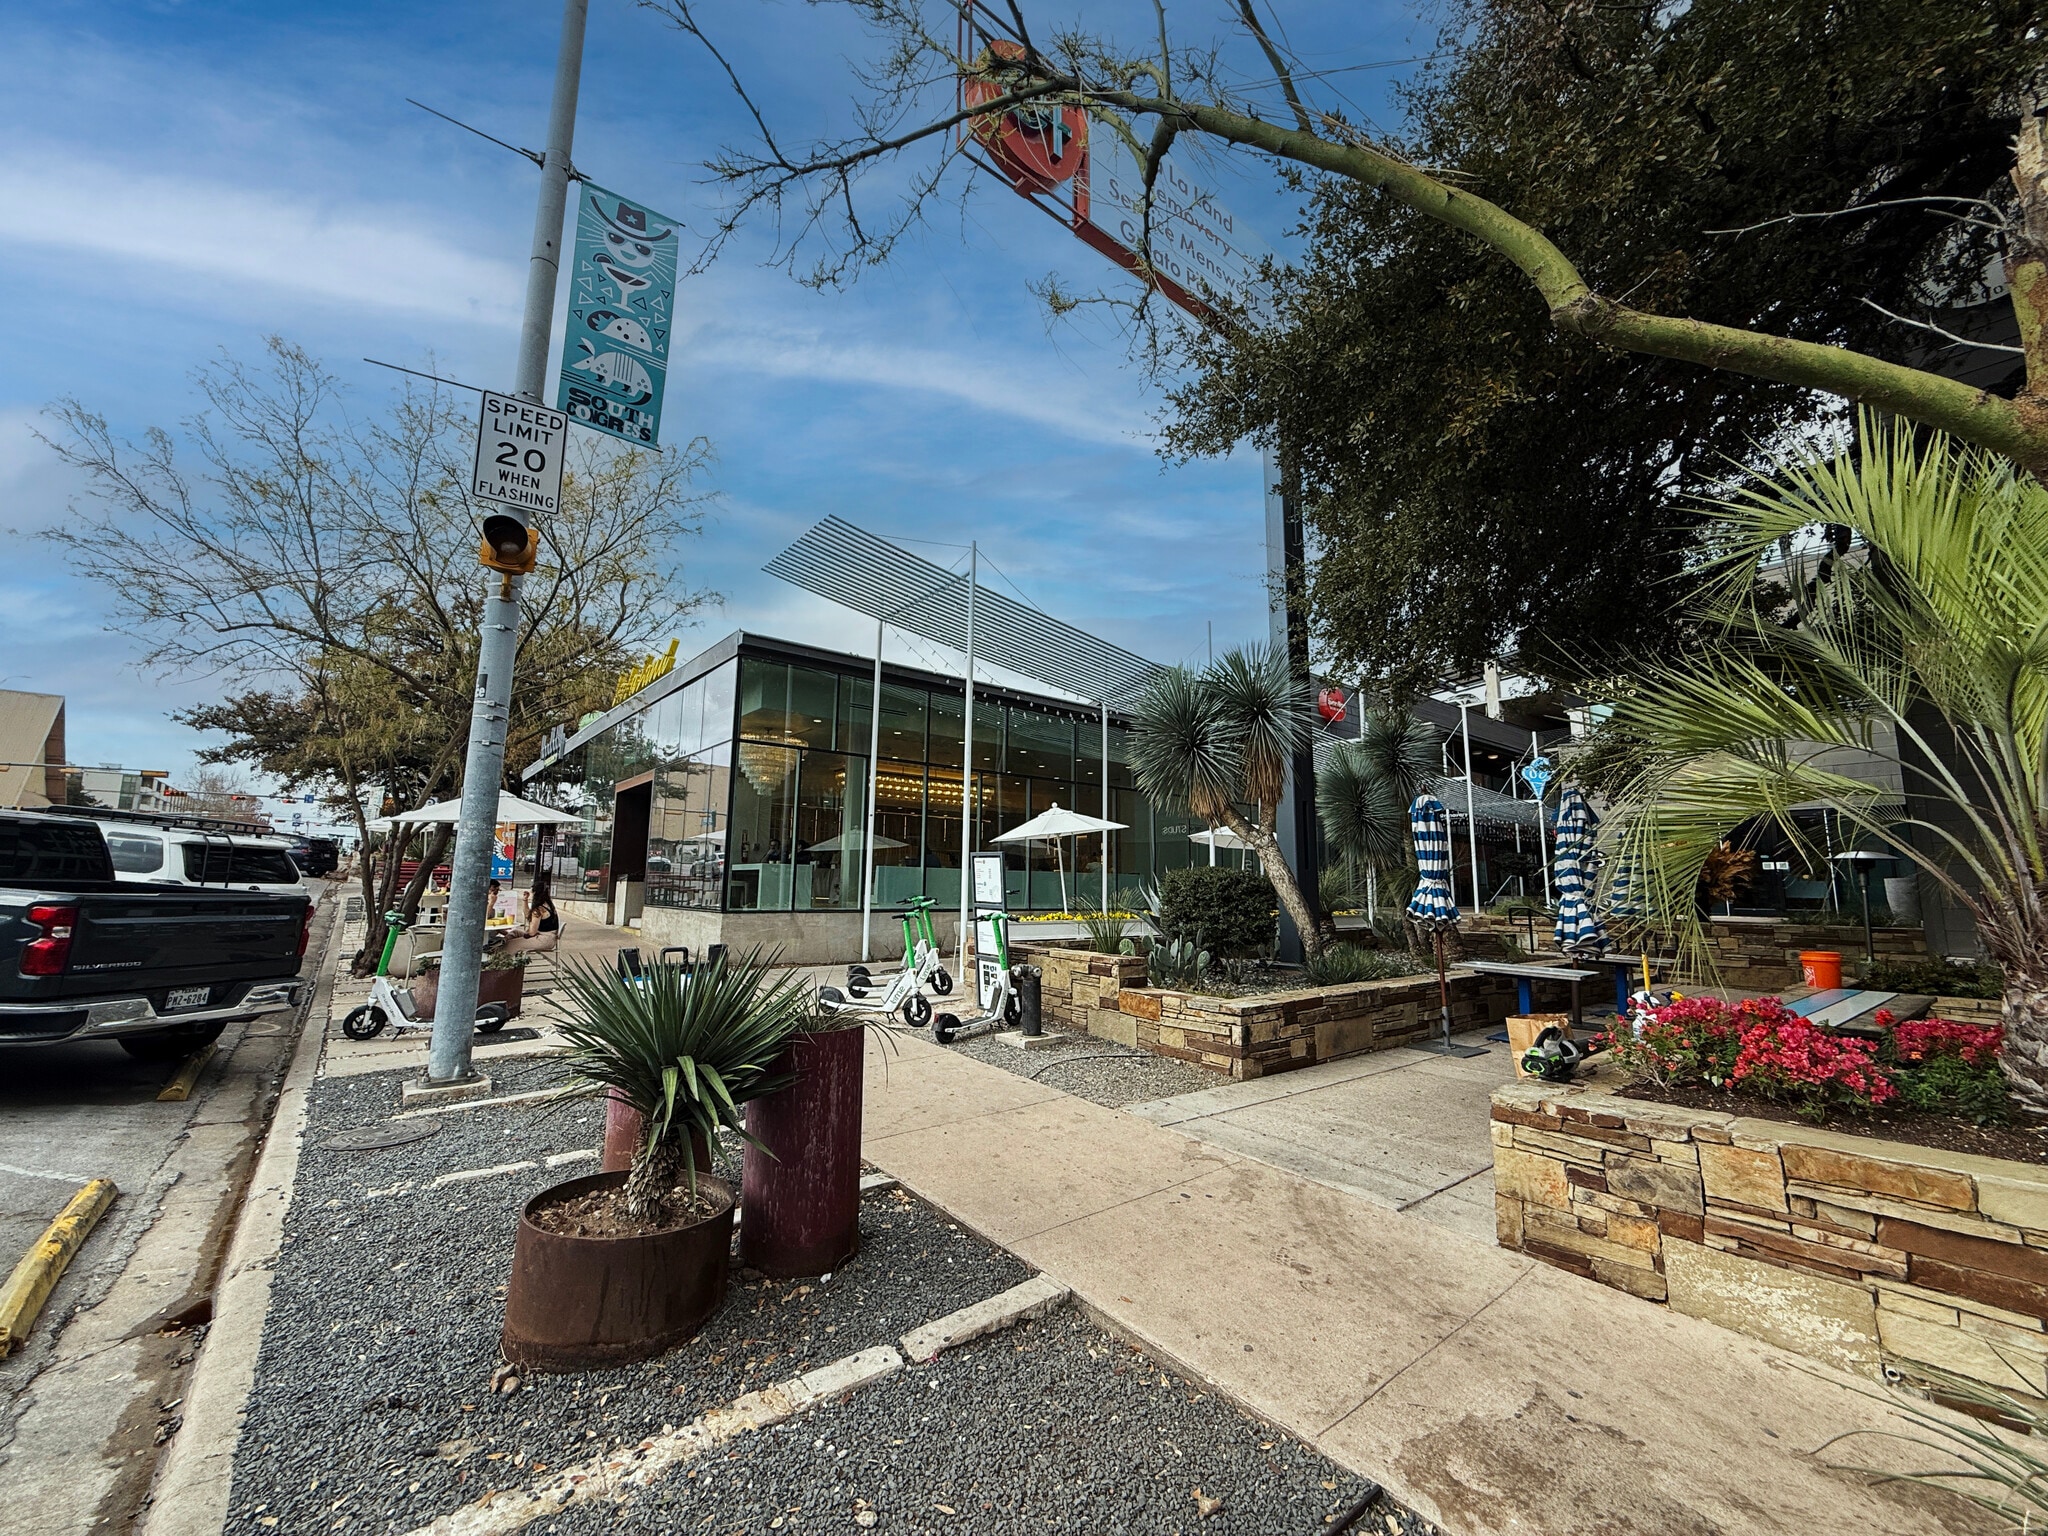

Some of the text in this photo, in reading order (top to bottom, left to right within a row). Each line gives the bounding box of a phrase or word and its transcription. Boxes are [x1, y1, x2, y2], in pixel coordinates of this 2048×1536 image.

[1109, 178, 1174, 243] Seice
[1169, 164, 1233, 234] La Land
[1155, 187, 1231, 256] emovery
[1120, 220, 1181, 278] Glato
[487, 399, 563, 431] SPEED
[566, 401, 652, 441] CONGRESS
[568, 387, 654, 429] SOUTH
[494, 418, 553, 445] LIMIT
[495, 442, 546, 473] 20
[479, 480, 554, 508] FLASHING
[499, 469, 540, 490] WHEN
[72, 961, 142, 971] SILVERADO
